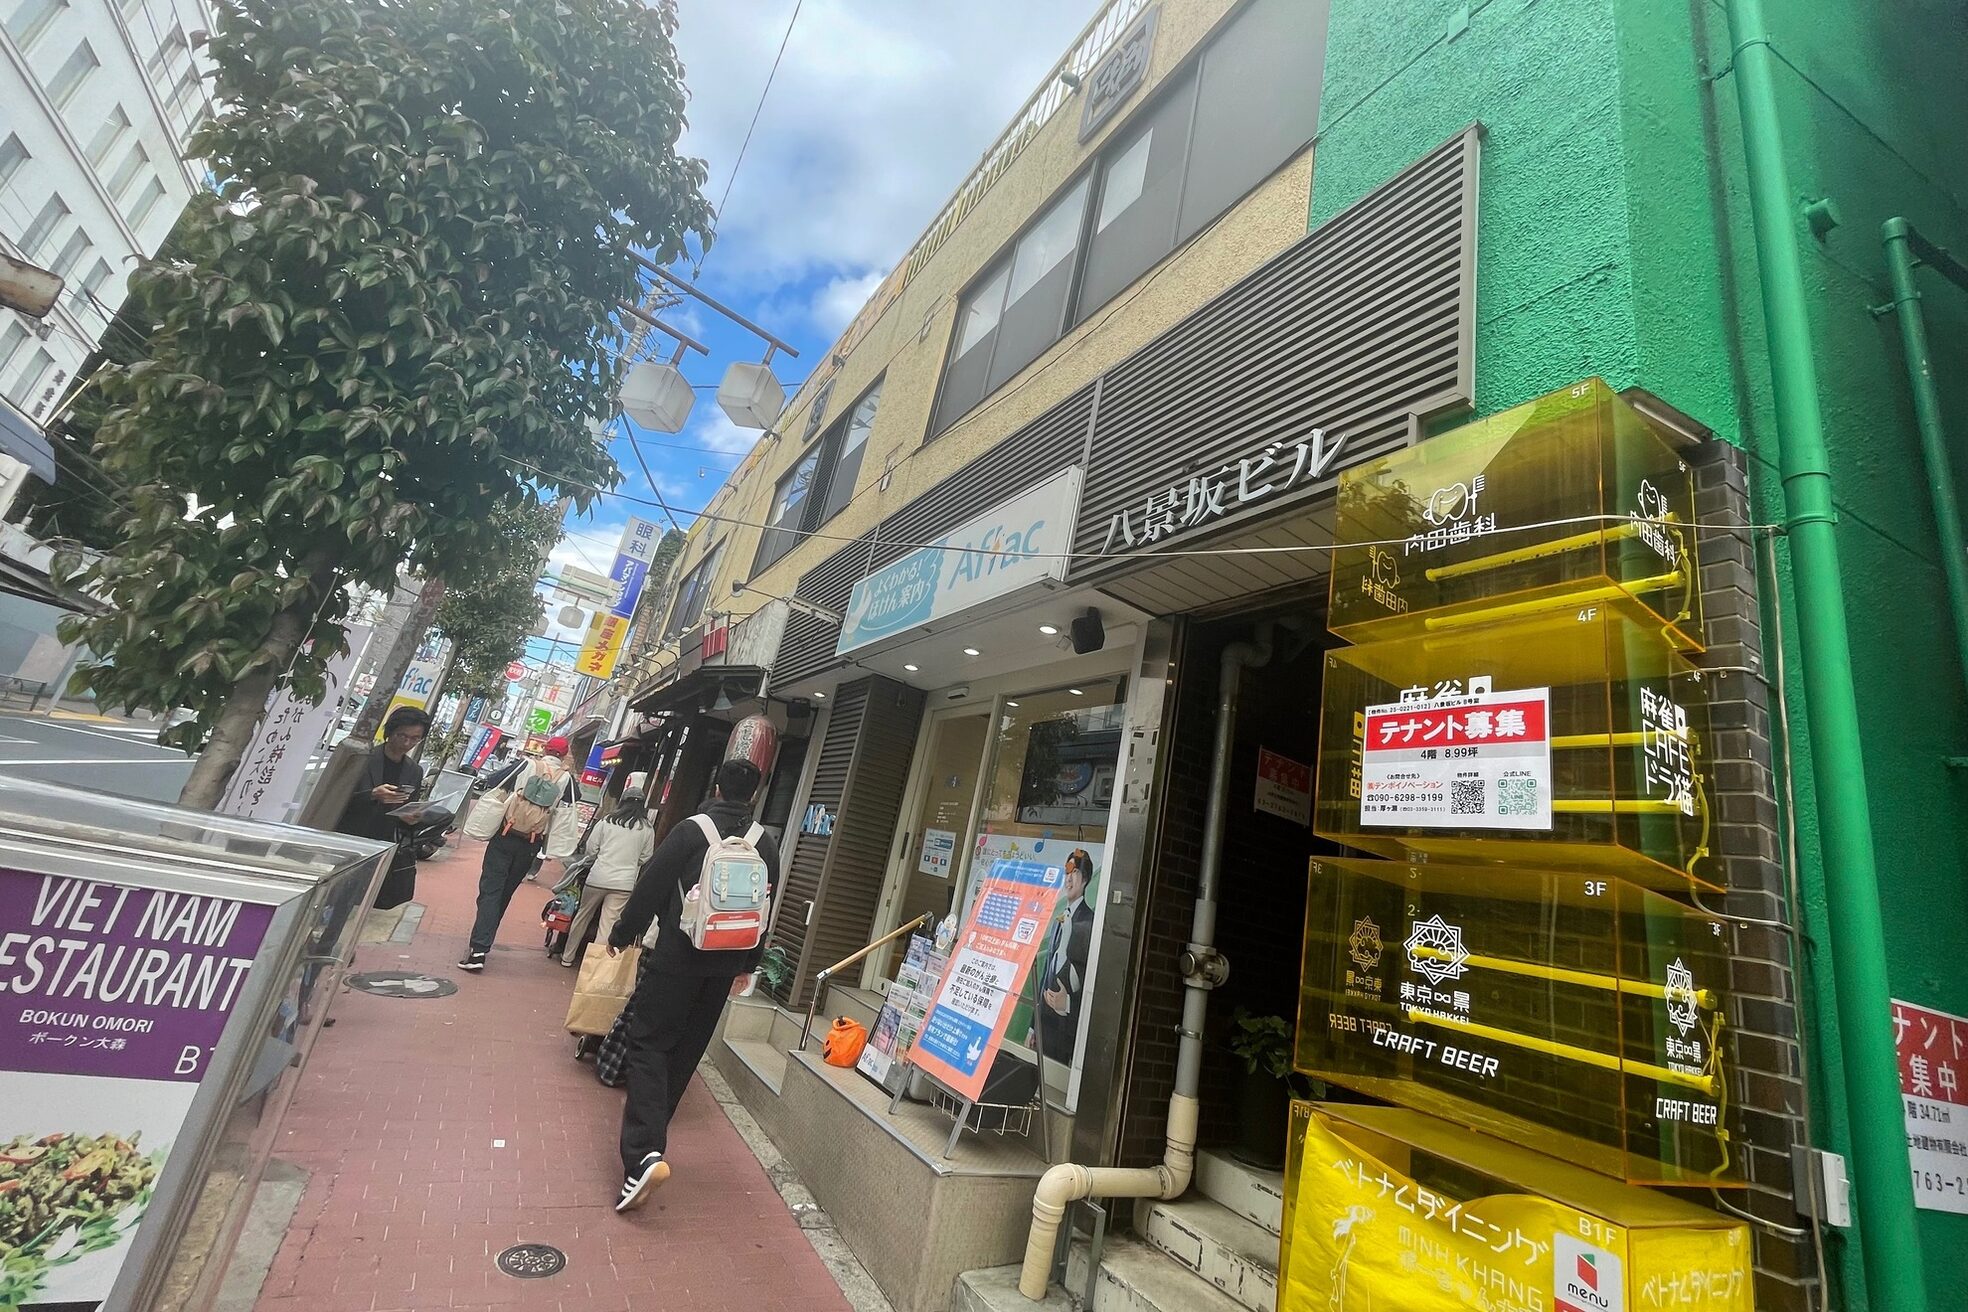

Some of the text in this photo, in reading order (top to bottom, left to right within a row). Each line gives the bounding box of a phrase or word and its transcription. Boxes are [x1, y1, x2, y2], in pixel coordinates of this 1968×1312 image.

[1572, 384, 1590, 398] 5F
[1100, 428, 1347, 556] 八景坂ビル
[630, 522, 653, 558] 眼科
[1405, 512, 1497, 557] 内田歯科
[948, 519, 1046, 590] Aflac
[1577, 608, 1597, 622] 4F
[401, 667, 433, 695] flac
[1640, 686, 1676, 731] 麻雀
[1380, 709, 1527, 745] テナント募集
[1421, 747, 1478, 759] 4階 8.99坪
[1642, 719, 1690, 776] CAFE
[1374, 793, 1443, 801] 090-6298-9199
[1584, 880, 1607, 896] 3F
[31, 876, 242, 949] VIET NAM
[19, 1009, 154, 1034] BOKUN OMORI
[1892, 1007, 1963, 1060] ナント
[29, 1030, 127, 1051] ボークン大森
[1373, 1028, 1499, 1078] CRAFT BEER
[174, 1046, 217, 1075] B
[1897, 1052, 1957, 1102] 集中
[1656, 1097, 1717, 1125] CRAFT BEER
[1913, 1170, 1968, 1195] 763-2
[1332, 1158, 1549, 1266] ベトナムダイニング
[1579, 1217, 1617, 1245] B1F
[1399, 1225, 1449, 1264] MINH
[1456, 1252, 1543, 1312] KHANG
[1568, 1282, 1609, 1308] menu
